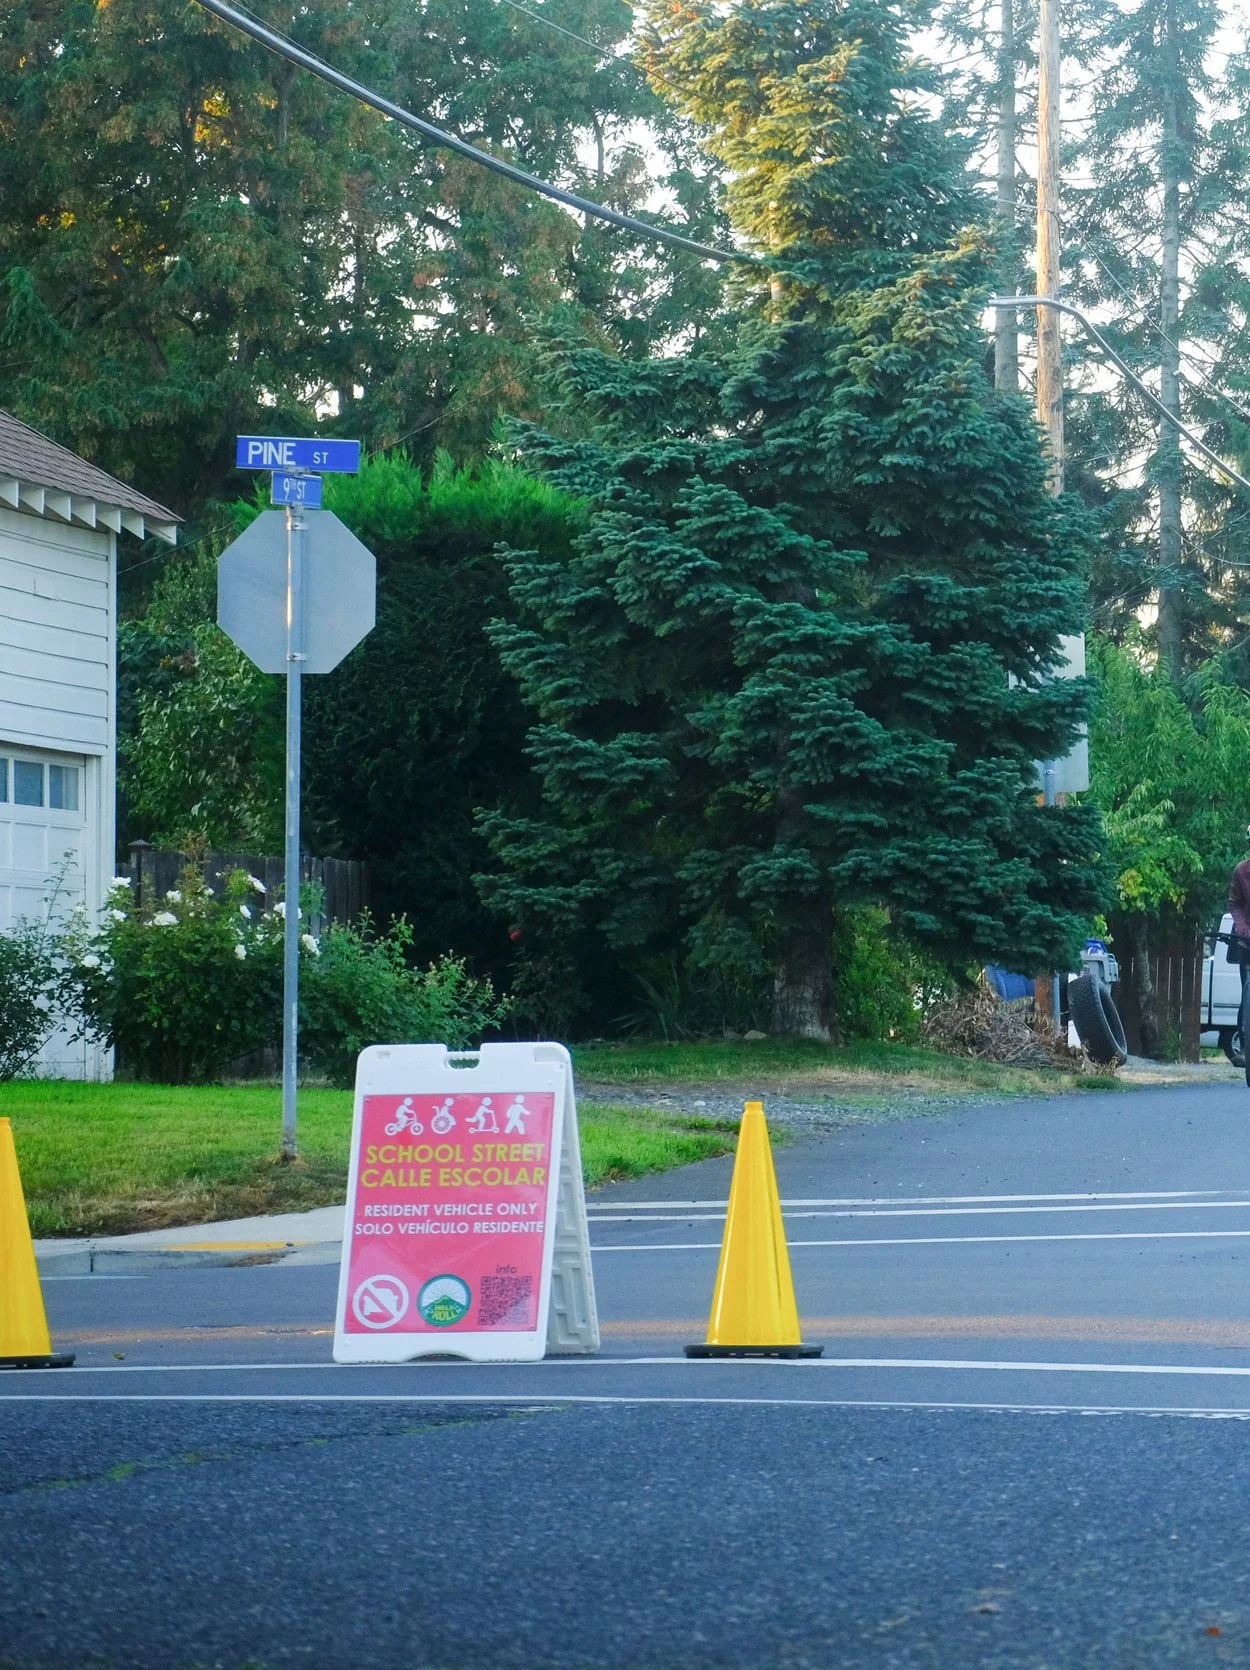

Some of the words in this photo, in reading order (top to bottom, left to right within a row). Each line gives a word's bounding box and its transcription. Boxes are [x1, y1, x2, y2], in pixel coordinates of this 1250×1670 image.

[248, 441, 296, 465] PINE
[313, 452, 329, 464] ST
[283, 479, 297, 500] 9TH
[296, 482, 307, 500] ST
[366, 1144, 465, 1164] SCHOOL
[471, 1143, 545, 1162] STREET
[361, 1168, 432, 1188] CALLE
[439, 1167, 546, 1186] ESCOLAR
[364, 1204, 429, 1217] RESIDENT
[433, 1203, 493, 1216] VEHICLE
[497, 1203, 538, 1215] ONLY
[355, 1223, 394, 1235] SOLO
[398, 1219, 469, 1234] VEHÍCULO
[473, 1221, 545, 1233] RESIDENTE
[496, 1264, 517, 1273] info
[431, 1310, 458, 1321] ROLL
